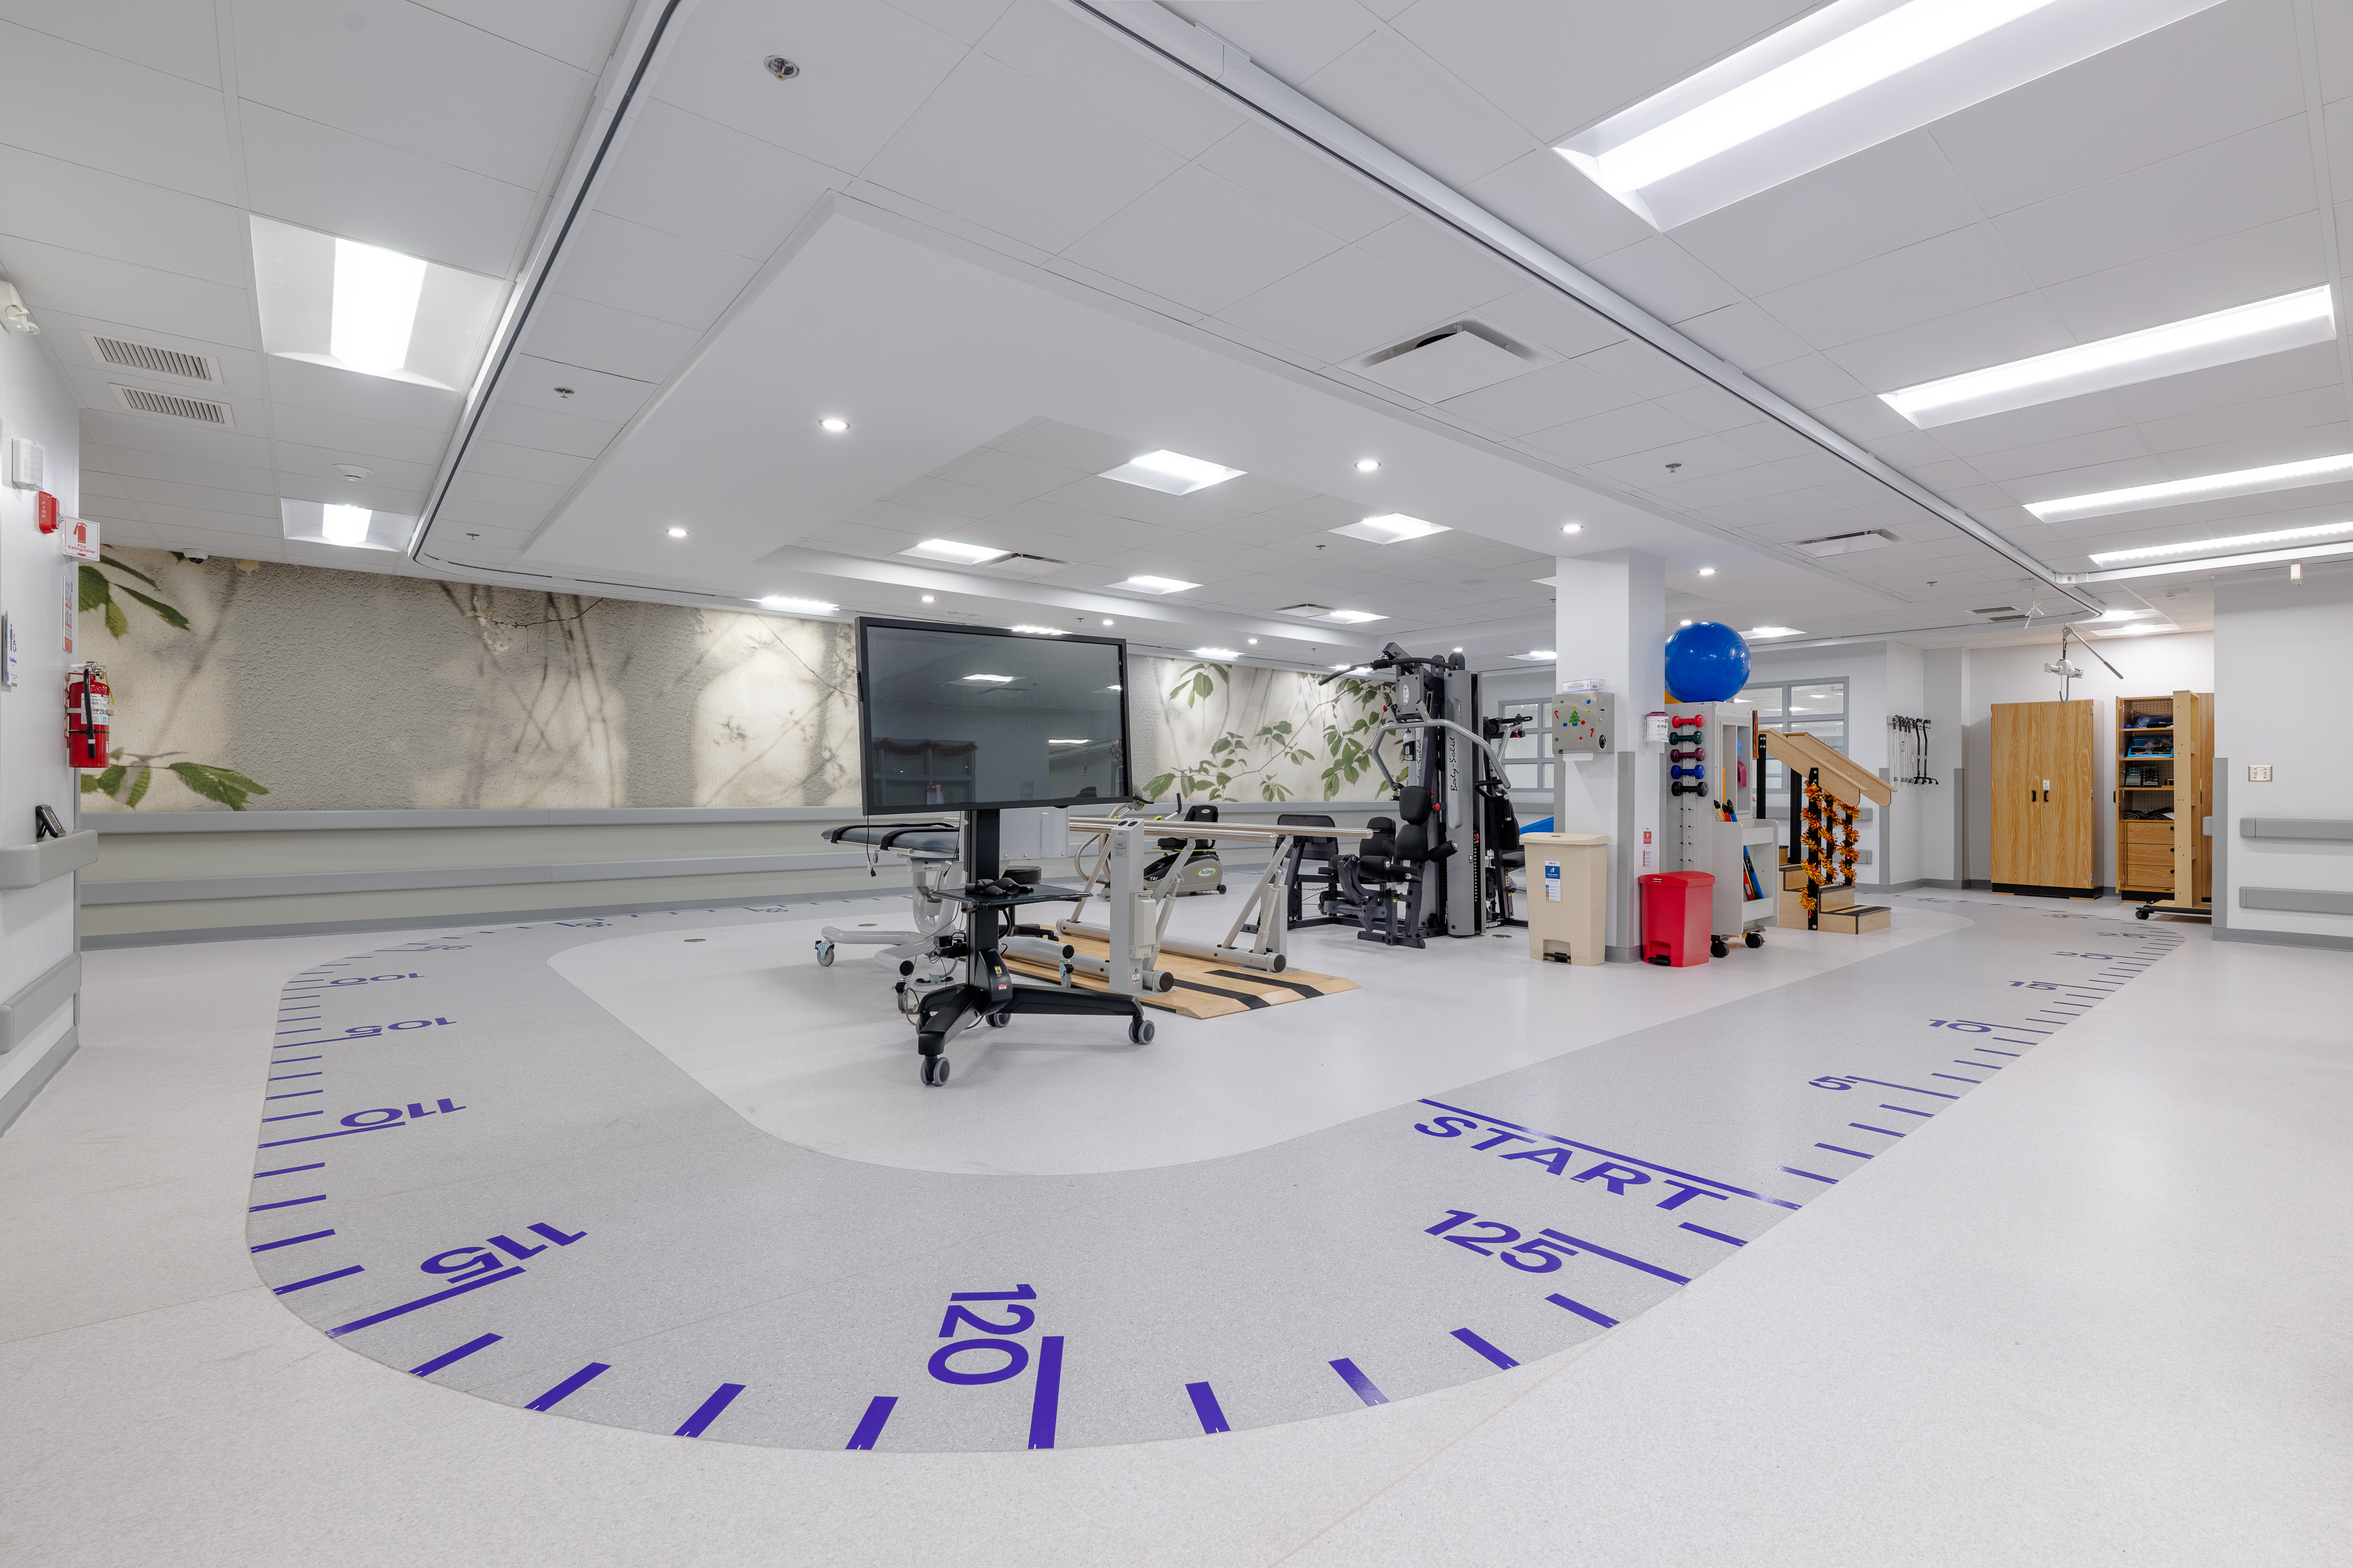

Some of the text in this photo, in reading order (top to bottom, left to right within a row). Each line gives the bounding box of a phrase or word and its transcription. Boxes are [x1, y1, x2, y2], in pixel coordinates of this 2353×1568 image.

[68, 544, 95, 554] Extinguisher
[1449, 737, 1459, 791] Body-Solid
[2050, 951, 2113, 960] 20
[329, 973, 425, 986] 100
[2007, 981, 2057, 991] 15
[345, 1017, 456, 1037] 105
[1928, 1019, 1991, 1033] 10
[1808, 1076, 1858, 1091] 5
[340, 1098, 467, 1127] 110
[1414, 1116, 1728, 1210] START
[1424, 1209, 1579, 1274] 125
[420, 1223, 588, 1284] 115
[928, 1284, 1037, 1385] 120
